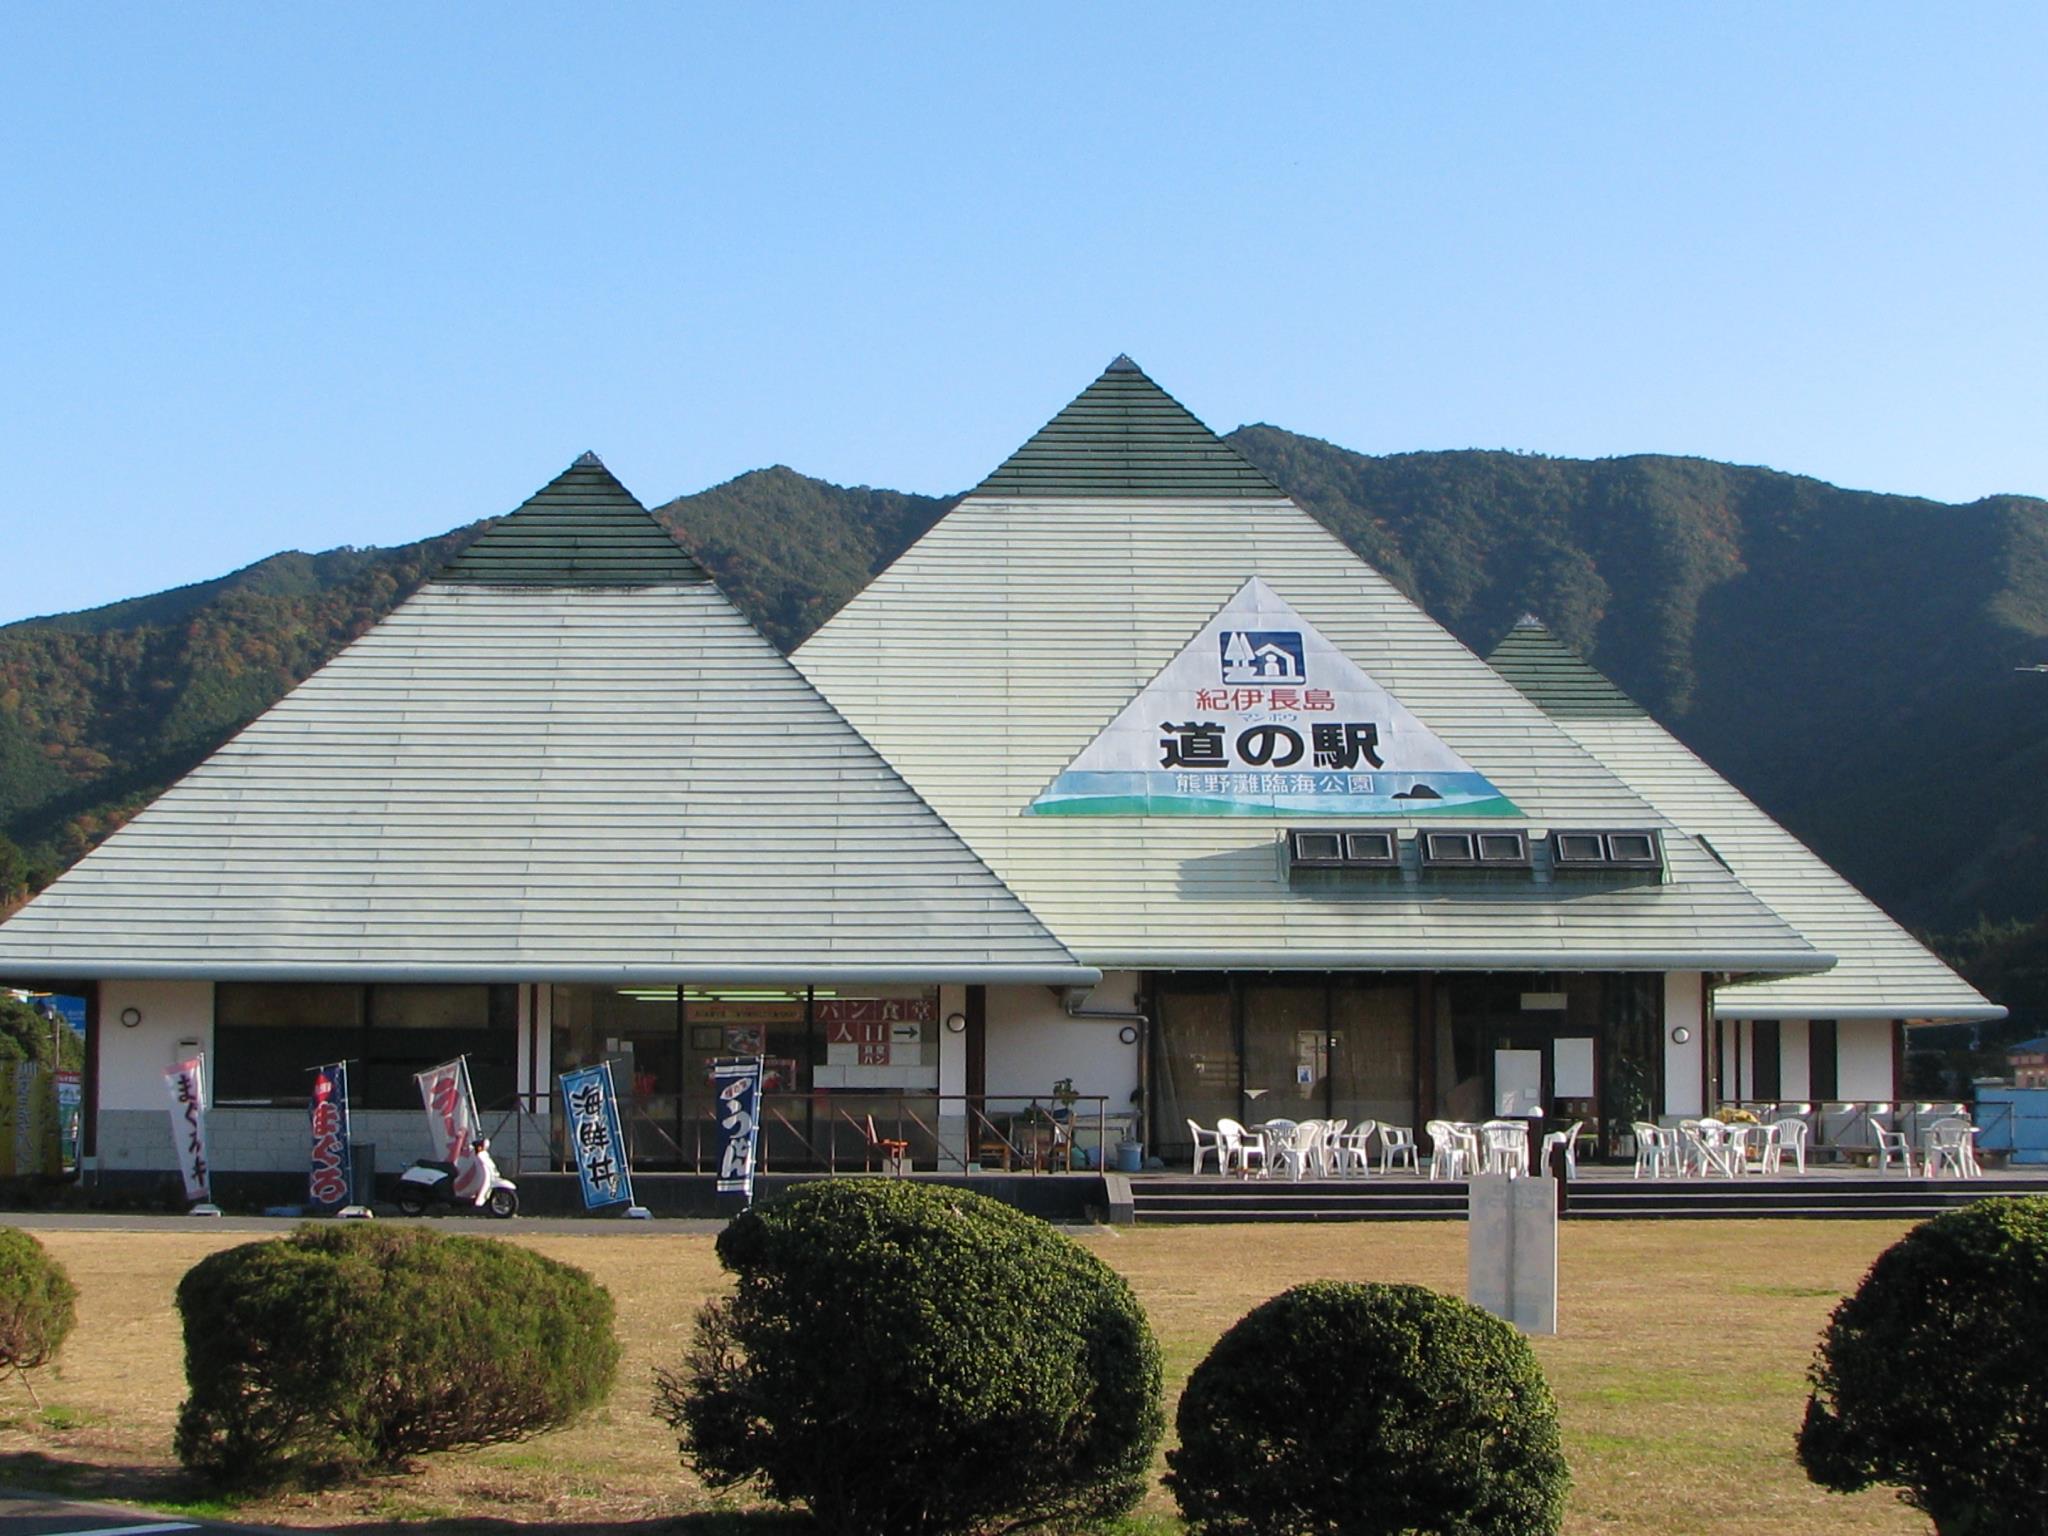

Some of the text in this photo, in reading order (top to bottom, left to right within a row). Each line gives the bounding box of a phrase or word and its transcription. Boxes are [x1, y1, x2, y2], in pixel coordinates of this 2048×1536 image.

[1196, 688, 1335, 711] 紀伊長島
[1160, 721, 1385, 769] 道の駅
[1175, 773, 1375, 794] 熊野灘臨海公園
[819, 1000, 932, 1020] パン食堂
[310, 1101, 348, 1204] まぐろ
[571, 1084, 616, 1190] 海鮮丼
[721, 1099, 752, 1179] うどん
